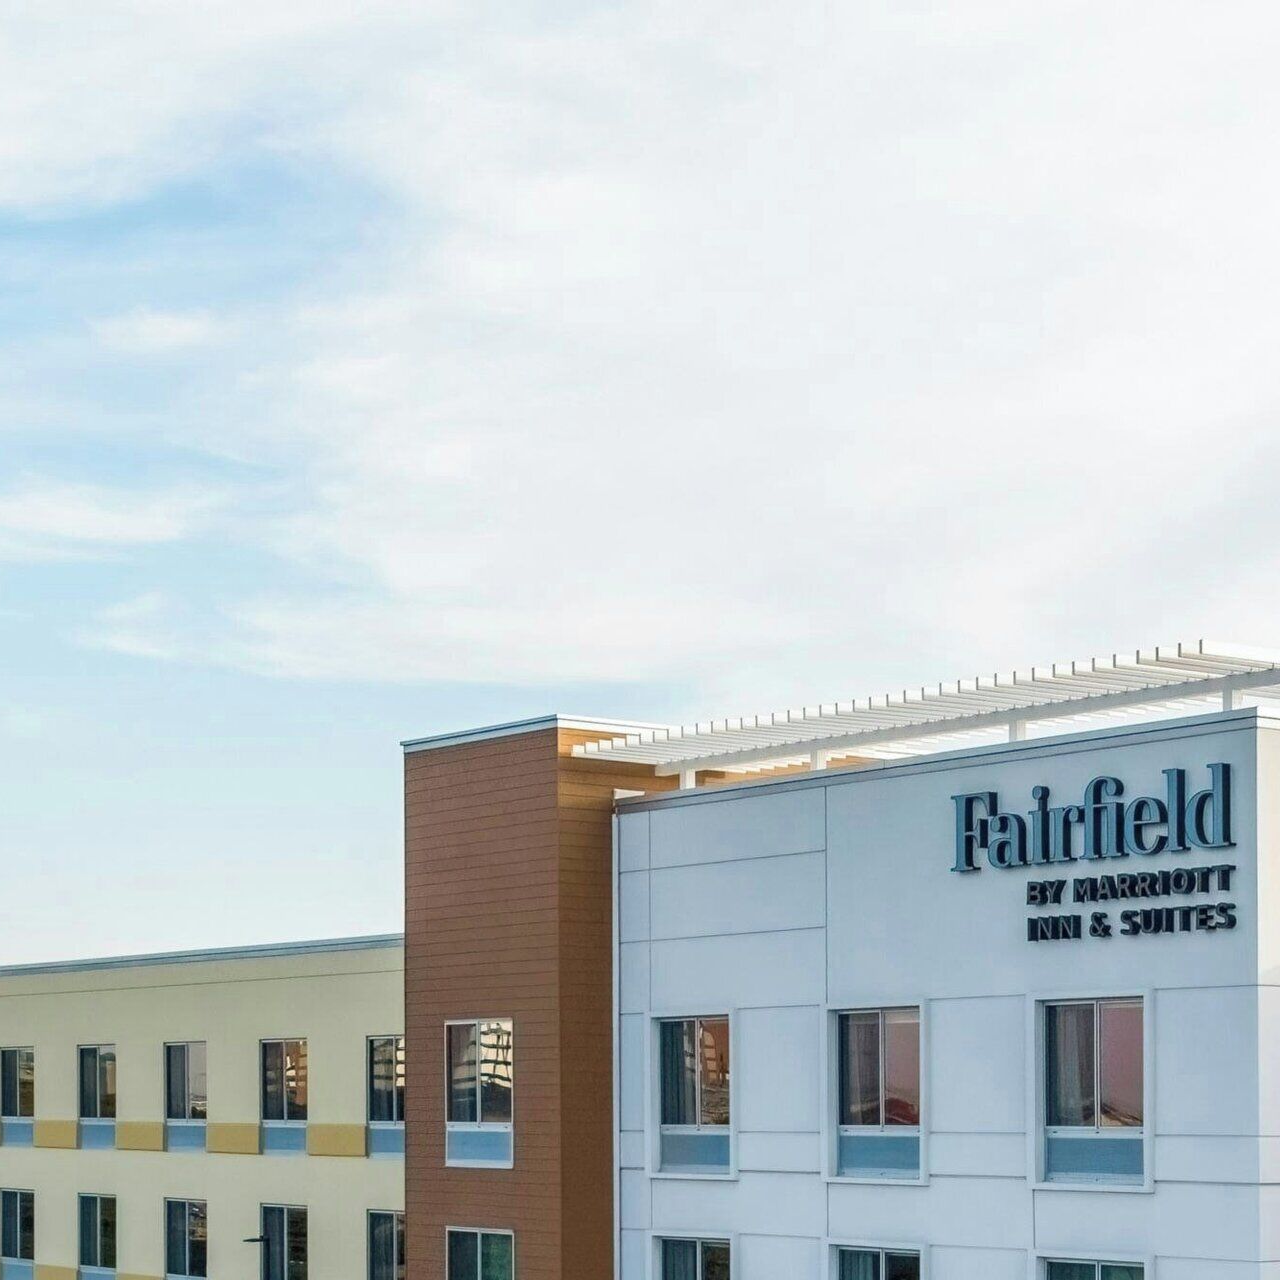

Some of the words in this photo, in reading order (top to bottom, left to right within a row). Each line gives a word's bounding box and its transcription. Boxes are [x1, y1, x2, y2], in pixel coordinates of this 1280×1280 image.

[950, 762, 1237, 872] Fairfield
[1026, 879, 1067, 905] BY
[1072, 864, 1236, 902] MARRIOTT
[1027, 914, 1082, 941] INN
[1089, 912, 1112, 937] &
[1120, 902, 1237, 935] SUITES
